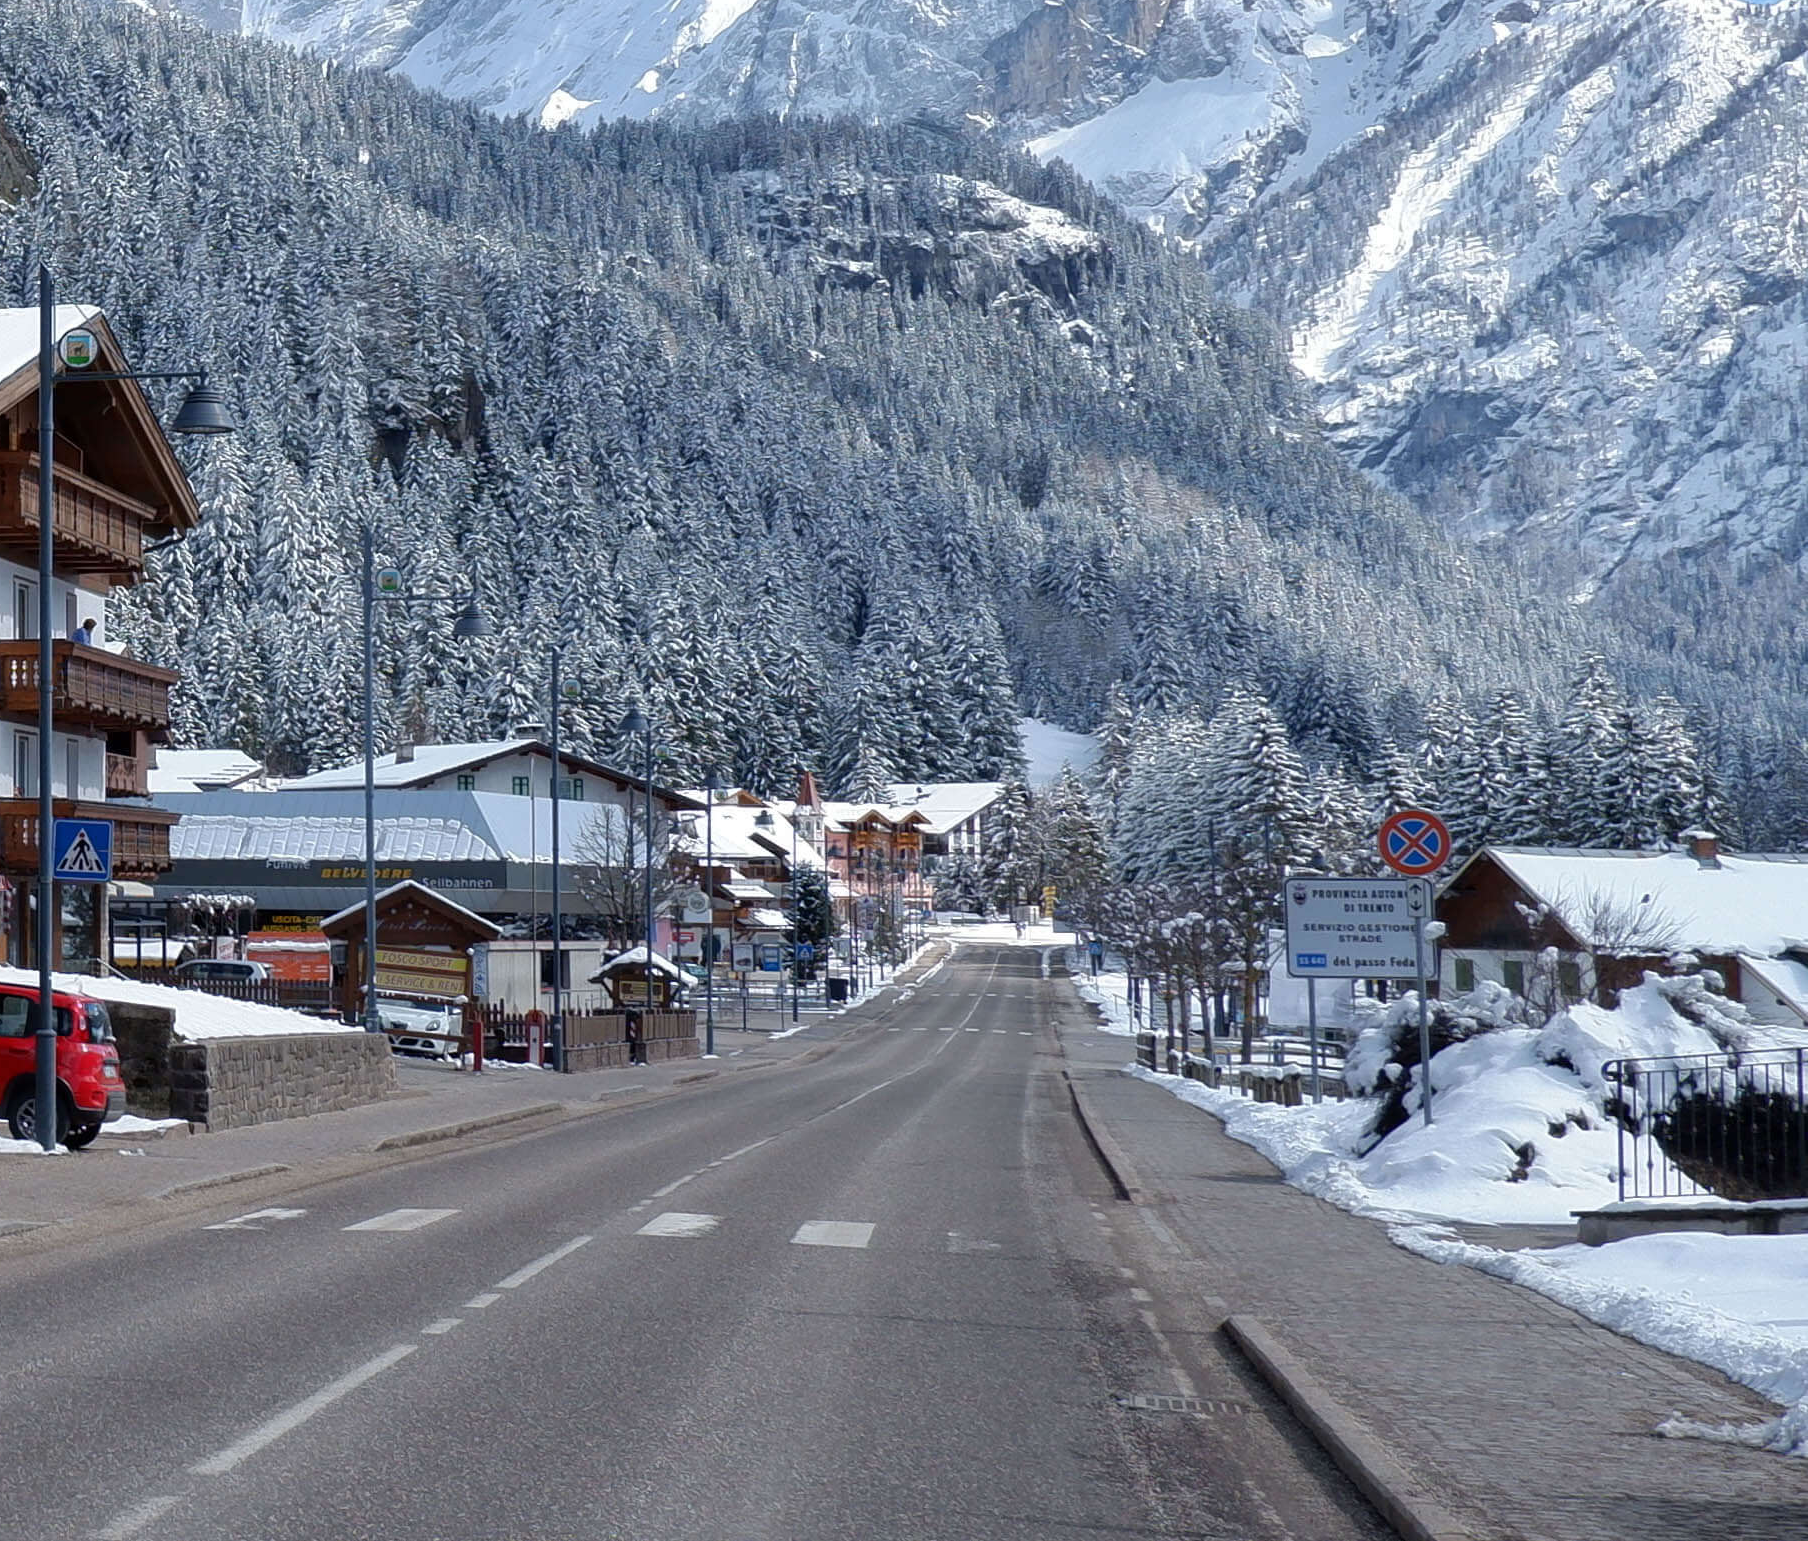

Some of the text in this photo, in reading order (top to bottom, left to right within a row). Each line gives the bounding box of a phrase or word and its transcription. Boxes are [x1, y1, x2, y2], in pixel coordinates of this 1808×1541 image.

[421, 877, 492, 888] Seilbahnen
[1311, 889, 1368, 899] PROVINCIA
[1344, 903, 1395, 913] DI TRENTO
[1302, 923, 1418, 933] SERVIZIO GESTIONE
[1338, 934, 1383, 943] STRADE
[381, 951, 453, 968] FOSCO SPORT
[1333, 956, 1350, 966] del
[1354, 958, 1386, 968] passo
[1390, 957, 1416, 967] Feda
[384, 974, 426, 988] SERVICE
